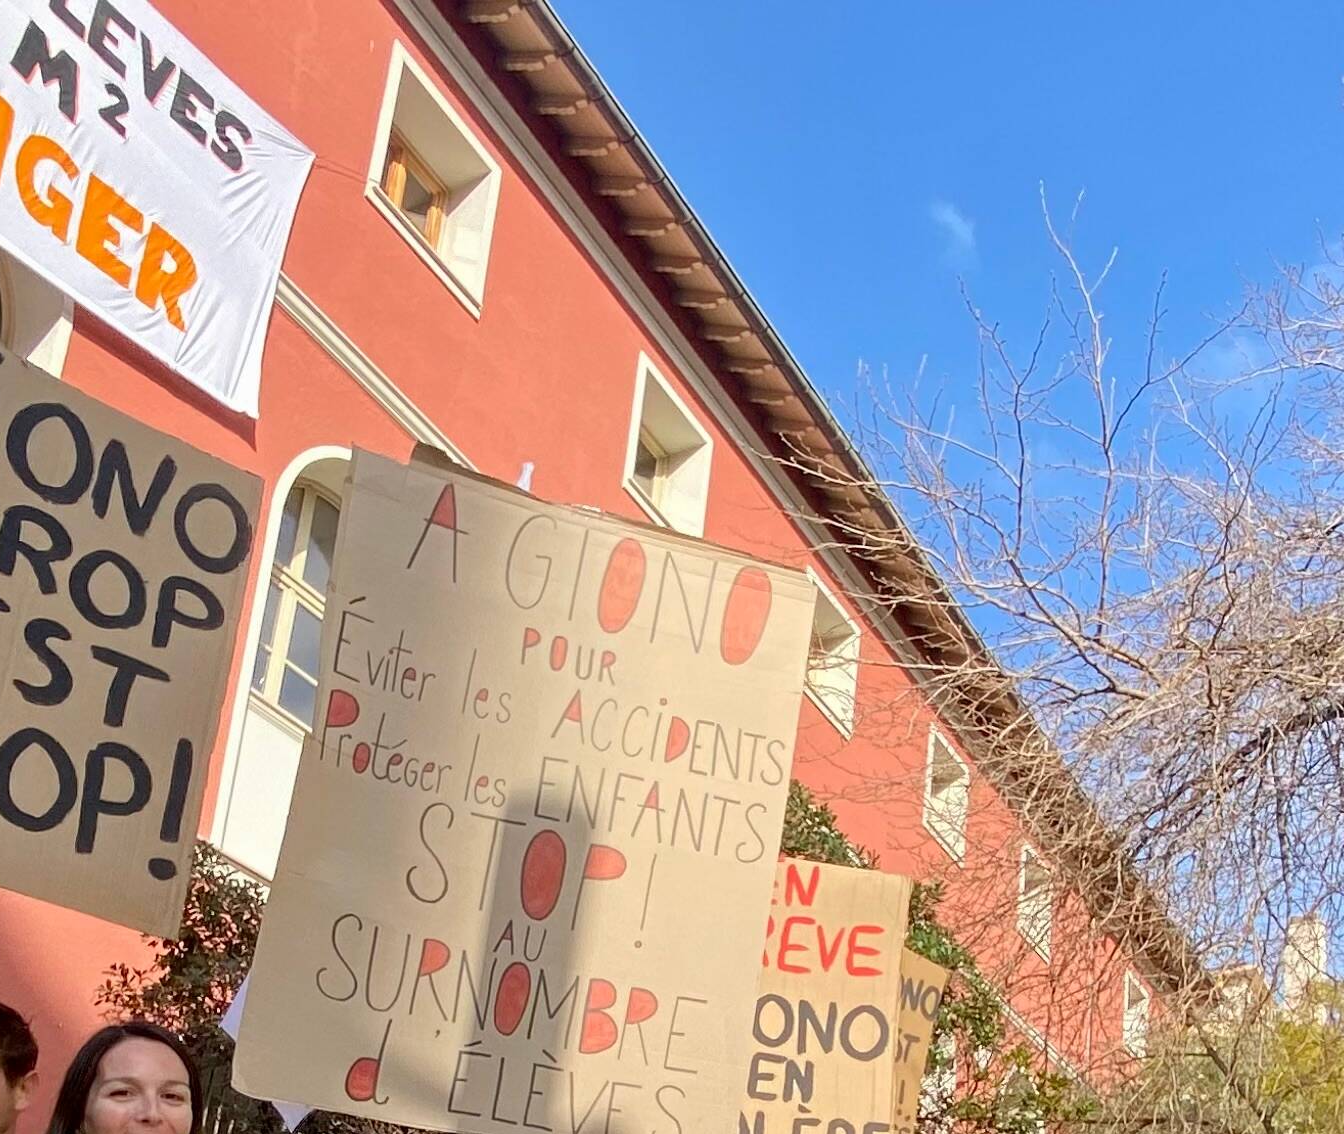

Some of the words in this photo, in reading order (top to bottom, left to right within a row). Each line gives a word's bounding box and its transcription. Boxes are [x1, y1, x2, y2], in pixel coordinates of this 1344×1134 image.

[407, 483, 469, 584] A
[505, 514, 773, 666] GIONO
[332, 595, 436, 703] Éviter
[461, 648, 512, 725] les
[521, 626, 618, 687] POUR
[464, 735, 507, 807] les
[534, 756, 768, 864] ENFANTS
[771, 863, 820, 907] N
[493, 919, 548, 963] AU
[316, 913, 708, 1075] SURNOMBRE
[747, 1052, 815, 1103] EN
